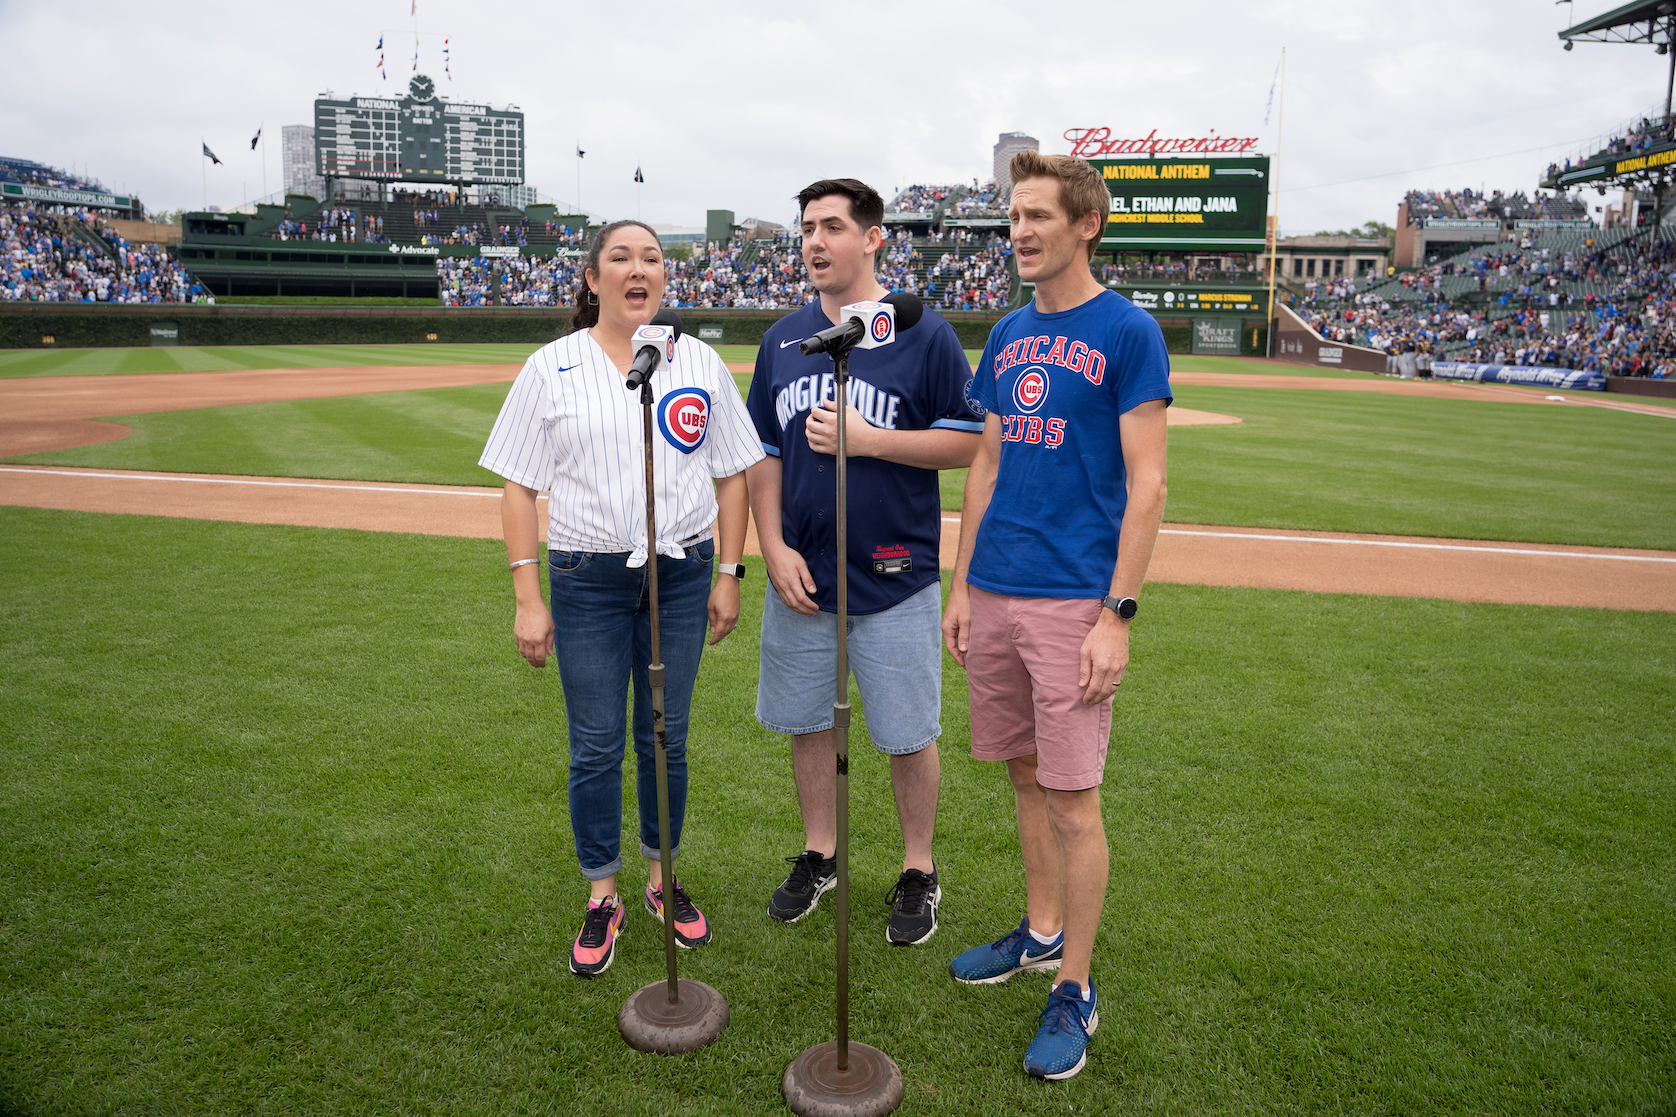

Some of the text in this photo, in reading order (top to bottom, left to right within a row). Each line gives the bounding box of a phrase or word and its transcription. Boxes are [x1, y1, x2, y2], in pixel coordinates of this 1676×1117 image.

[357, 99, 401, 110] NATIONAL
[444, 104, 486, 115] AMERICAN
[1064, 127, 1259, 157] Budweiser
[1616, 155, 1647, 174] NATIONAL
[1103, 165, 1210, 179] NATIONAL ANTHEM
[1132, 196, 1173, 212] ETHAN
[1174, 196, 1202, 212] AND
[1202, 197, 1238, 213] JANA
[1146, 214, 1174, 223] MIDDLE
[1174, 214, 1204, 223] SCHOOL
[400, 245, 440, 254] Advocate
[480, 246, 520, 254] GRAINGER
[701, 329, 722, 338] Hefty
[1198, 328, 1236, 337] DRAFT
[994, 335, 1106, 386] CHICAGO
[1020, 375, 1042, 404] CUBS
[669, 397, 706, 443] CUBS
